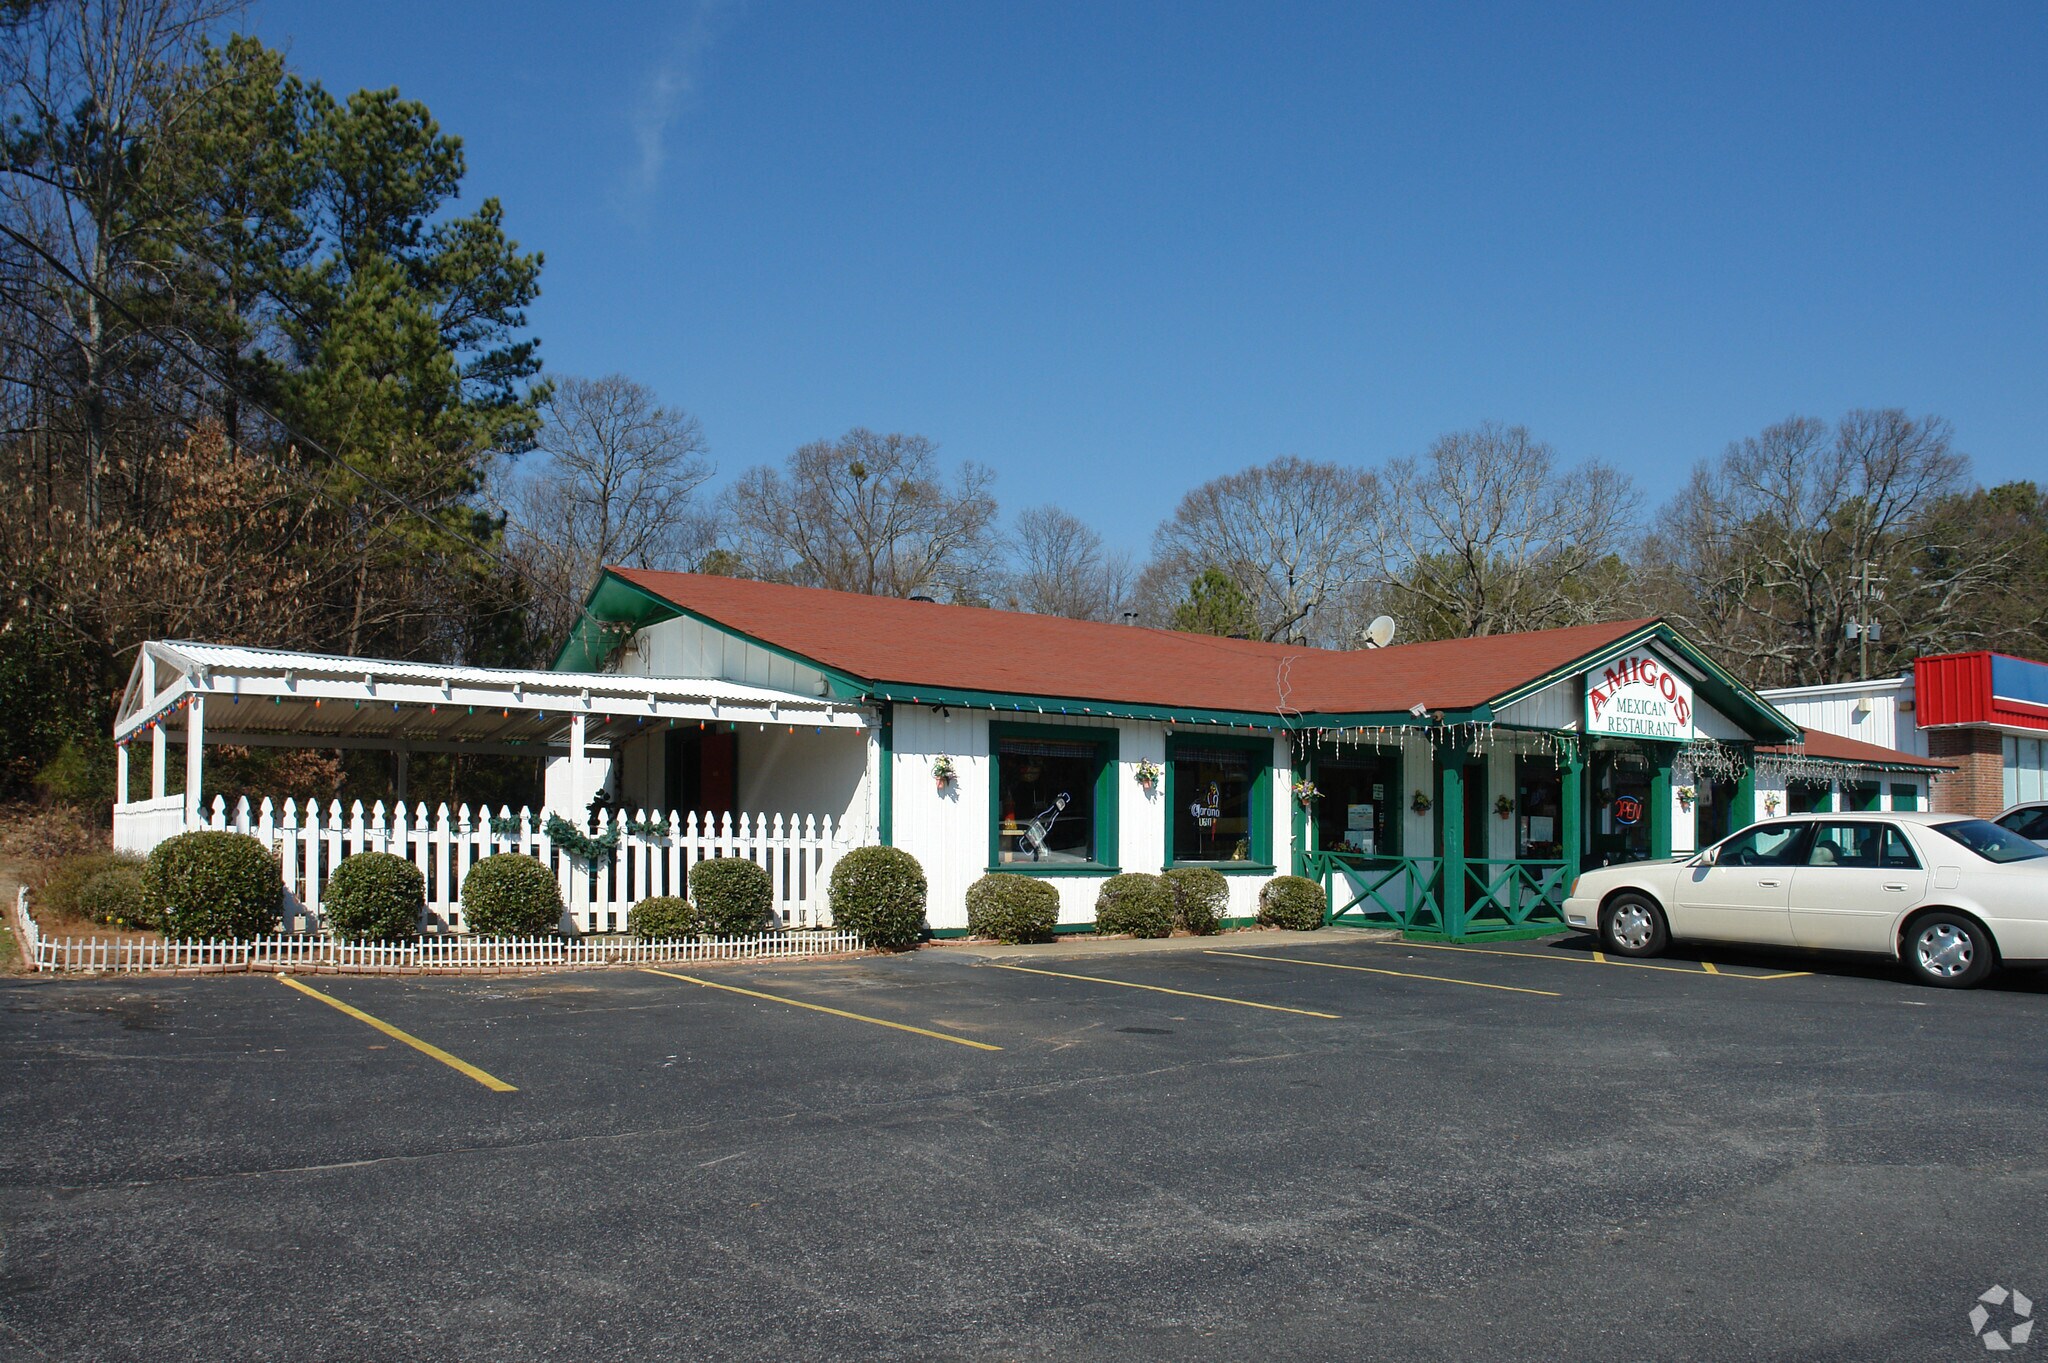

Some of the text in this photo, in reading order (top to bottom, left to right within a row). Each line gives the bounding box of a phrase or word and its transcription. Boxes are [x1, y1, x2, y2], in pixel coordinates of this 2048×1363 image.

[1589, 656, 1691, 727] AMIGOS
[1616, 697, 1667, 716] MEXICAN
[1608, 716, 1677, 737] RESTAURANT
